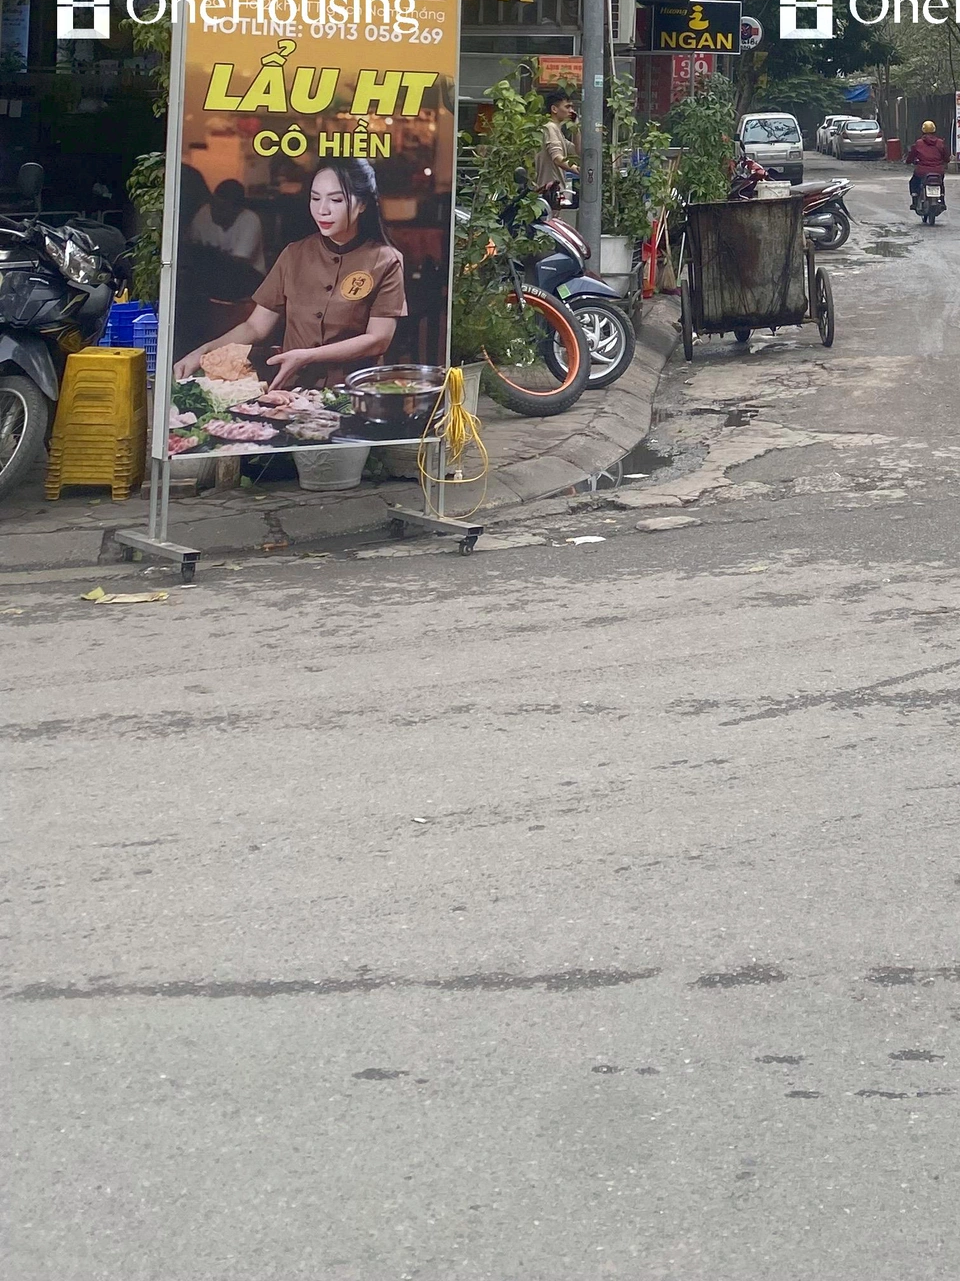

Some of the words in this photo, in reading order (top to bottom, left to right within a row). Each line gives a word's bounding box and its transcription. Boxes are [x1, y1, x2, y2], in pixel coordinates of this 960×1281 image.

[203, 16, 303, 39] HOTLINE:
[310, 22, 359, 41] 0913
[408, 26, 444, 45] 269
[660, 31, 734, 50] NGAN
[203, 39, 341, 114] LẨU
[350, 69, 439, 116] HT
[253, 123, 308, 158] CÔ
[318, 119, 391, 158] HIỀN
